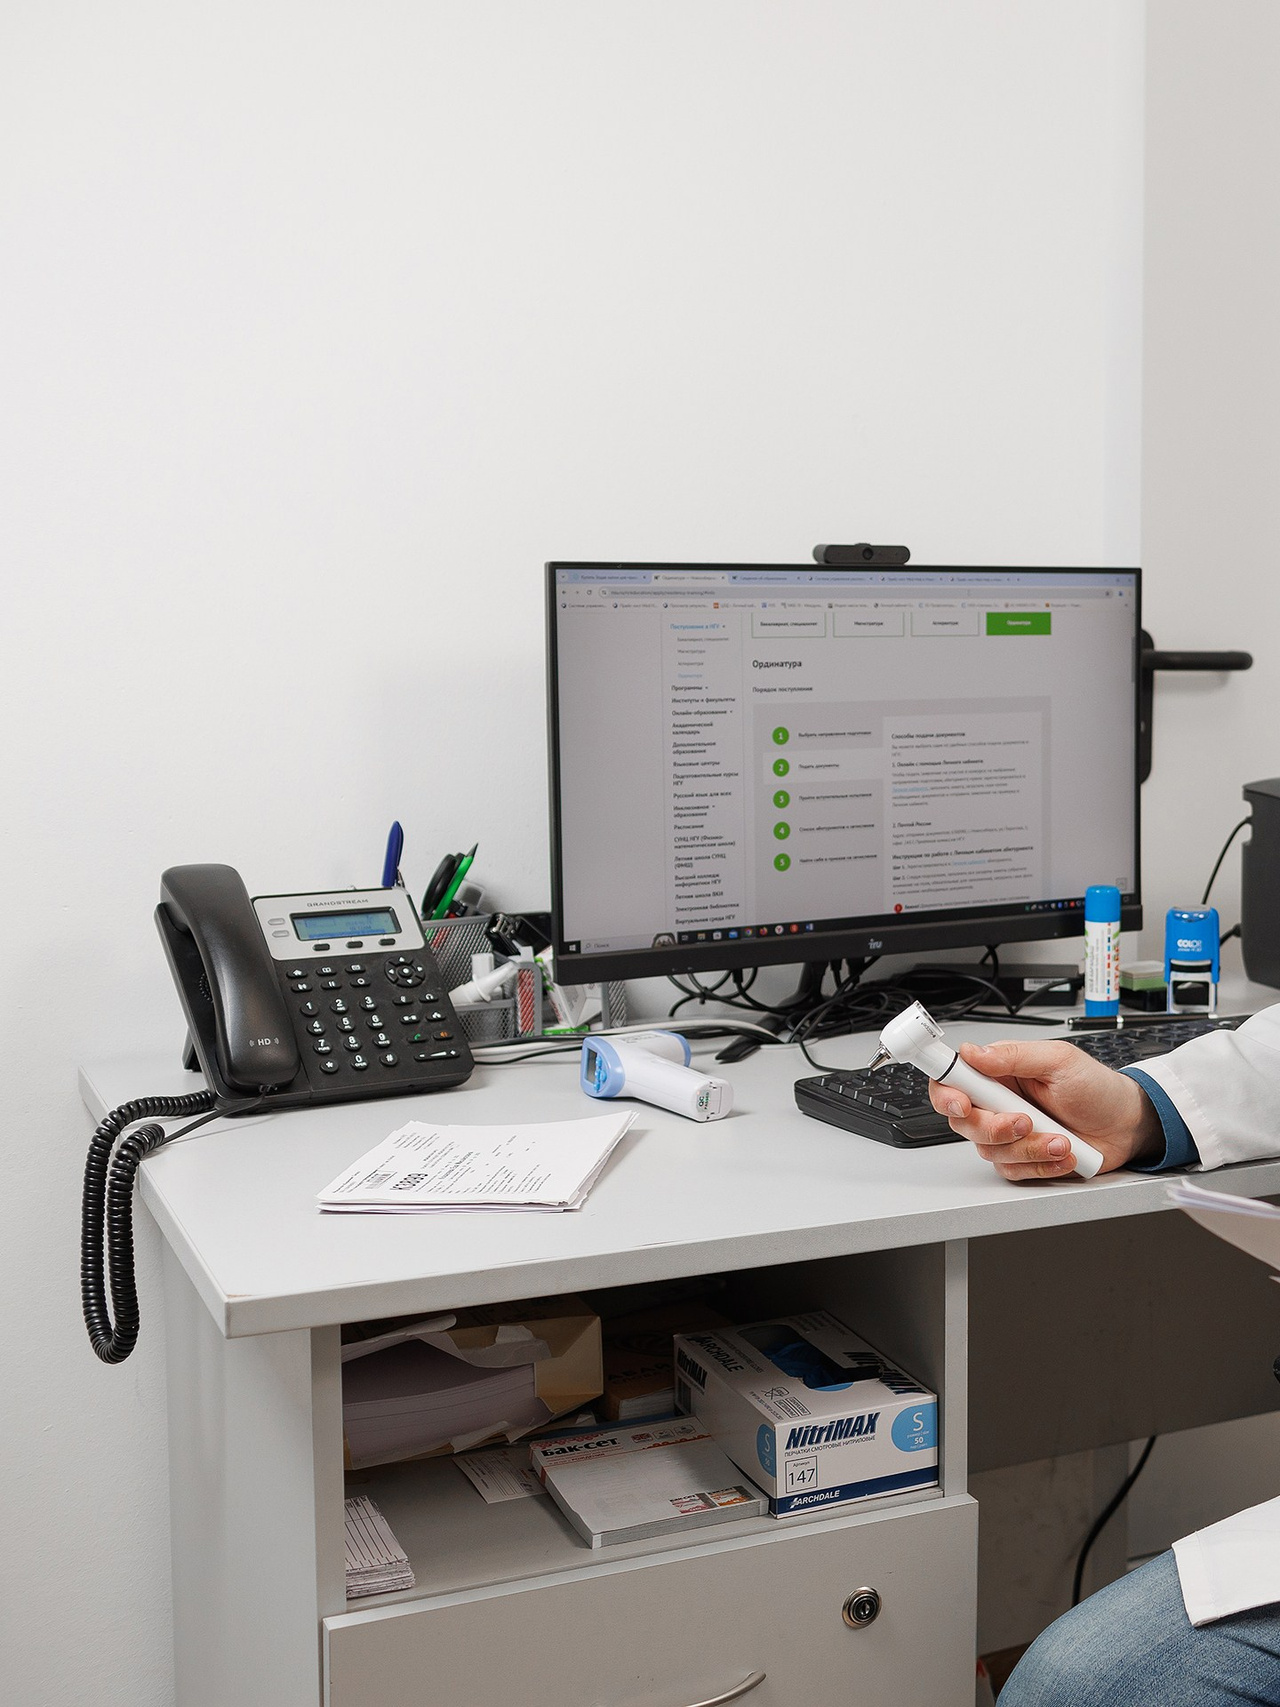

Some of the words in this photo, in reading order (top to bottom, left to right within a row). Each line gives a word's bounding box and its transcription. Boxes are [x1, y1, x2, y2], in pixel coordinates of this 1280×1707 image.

[752, 659, 802, 669] Ординатура
[779, 826, 786, 835] 4
[306, 899, 368, 908] GRANDSTREAM
[335, 999, 343, 1007] 2
[364, 996, 373, 1004] 3
[306, 1002, 312, 1010] 1
[342, 1017, 349, 1025] 5
[371, 1014, 379, 1022] 6
[313, 1020, 320, 1028] 4
[348, 1036, 356, 1044] 8
[378, 1032, 386, 1040] 9
[257, 1038, 271, 1046] HD
[318, 1039, 325, 1047] 7
[355, 1054, 363, 1063] 0
[913, 1412, 924, 1432] S
[785, 1412, 881, 1450] NitriMAX
[763, 1433, 770, 1452] S
[914, 1436, 924, 1444] 50
[541, 1437, 619, 1457] Бак-сет
[784, 1448, 811, 1458] ПЕРЧАТКИ
[811, 1442, 842, 1453] СМОТРОВЫЕ
[842, 1435, 876, 1446] НИТРИЛОВЫЕ
[789, 1468, 815, 1486] 147
[796, 1490, 841, 1506] ARCHDALE
